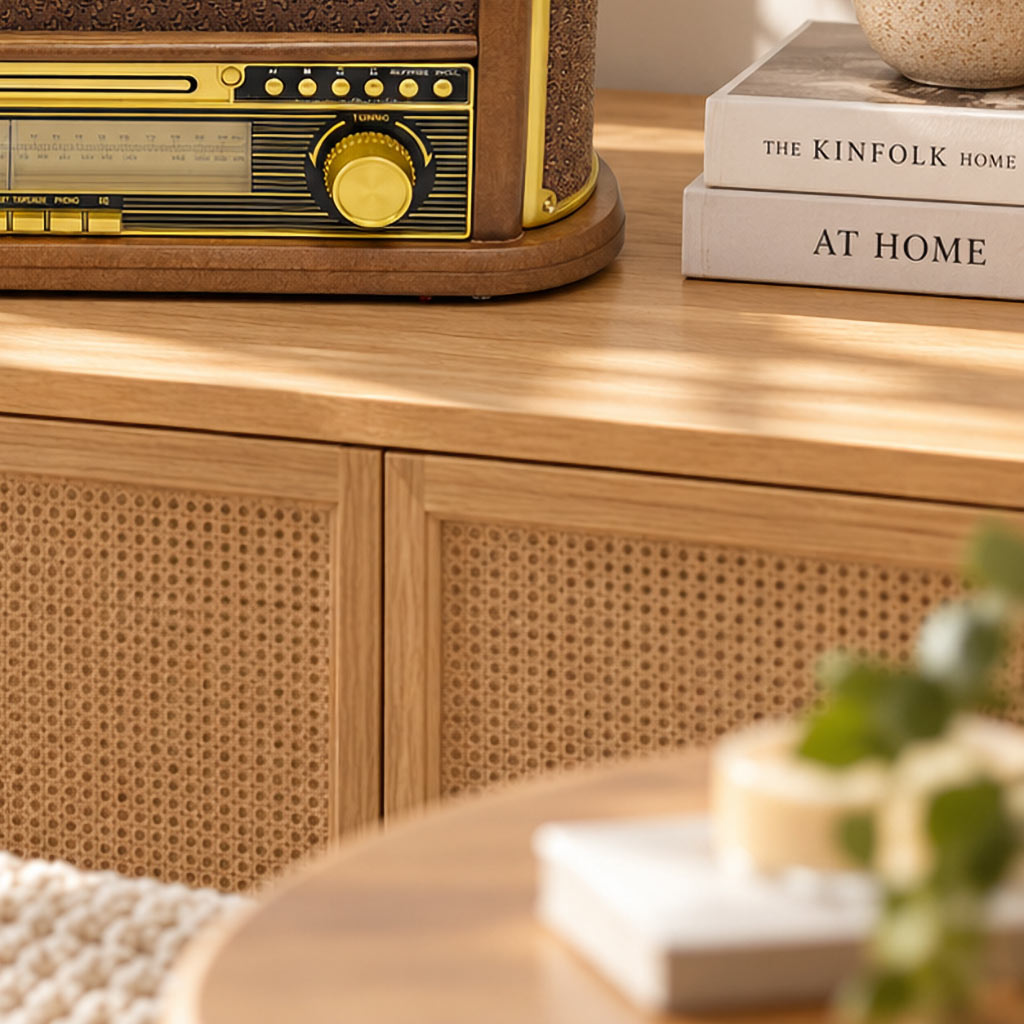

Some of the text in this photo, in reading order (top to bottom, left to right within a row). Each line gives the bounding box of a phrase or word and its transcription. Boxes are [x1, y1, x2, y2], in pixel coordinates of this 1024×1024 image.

[763, 139, 1017, 170] THE KINFOLK HOME
[813, 228, 987, 266] AT HOME
